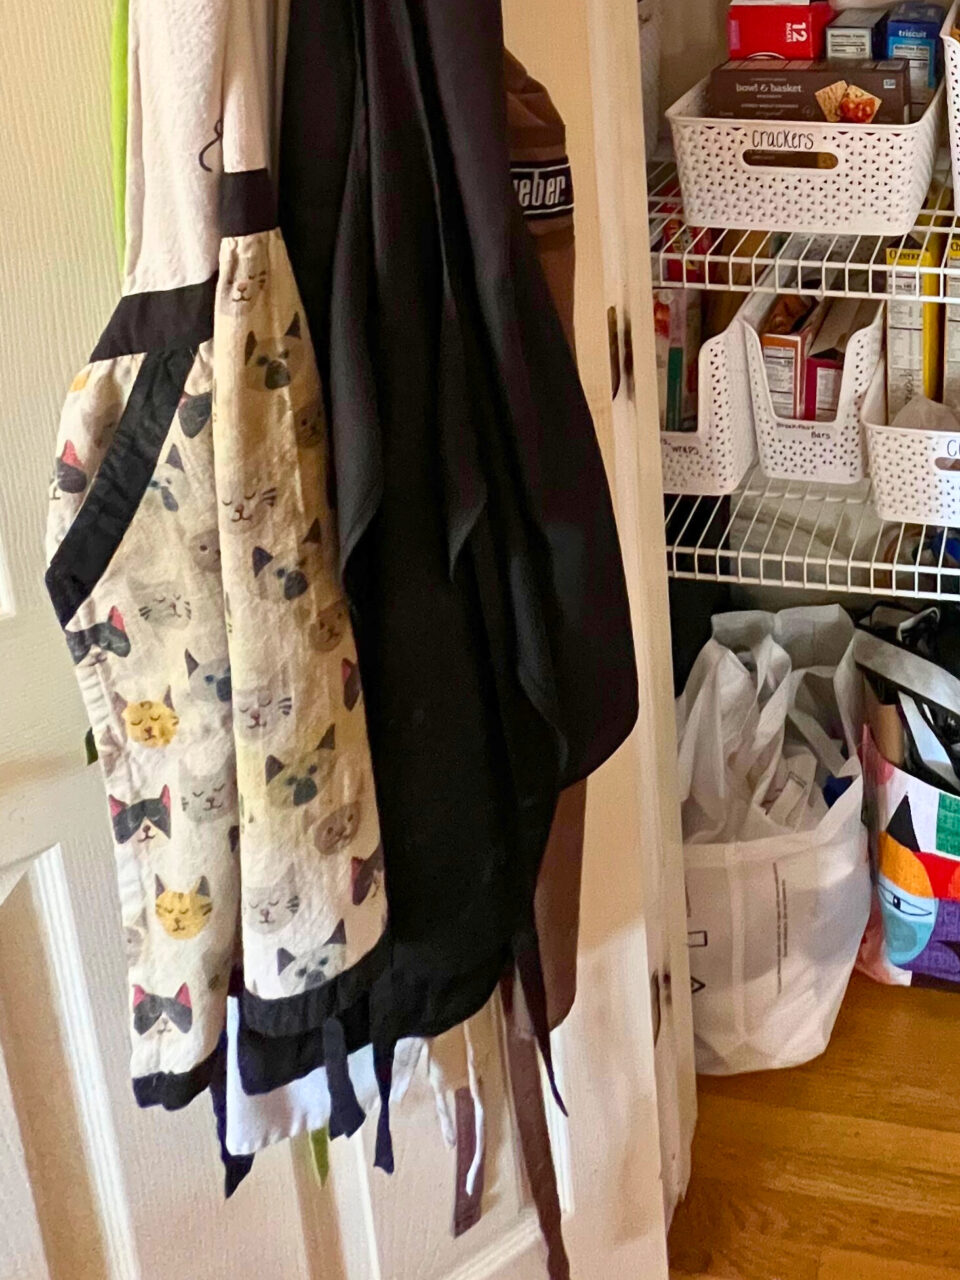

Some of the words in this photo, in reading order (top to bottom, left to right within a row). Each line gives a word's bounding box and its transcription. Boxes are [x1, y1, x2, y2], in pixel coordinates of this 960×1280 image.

[792, 22, 808, 42] 12
[898, 29, 928, 39] triscuit
[736, 82, 758, 93] bowl
[770, 83, 802, 93] basket
